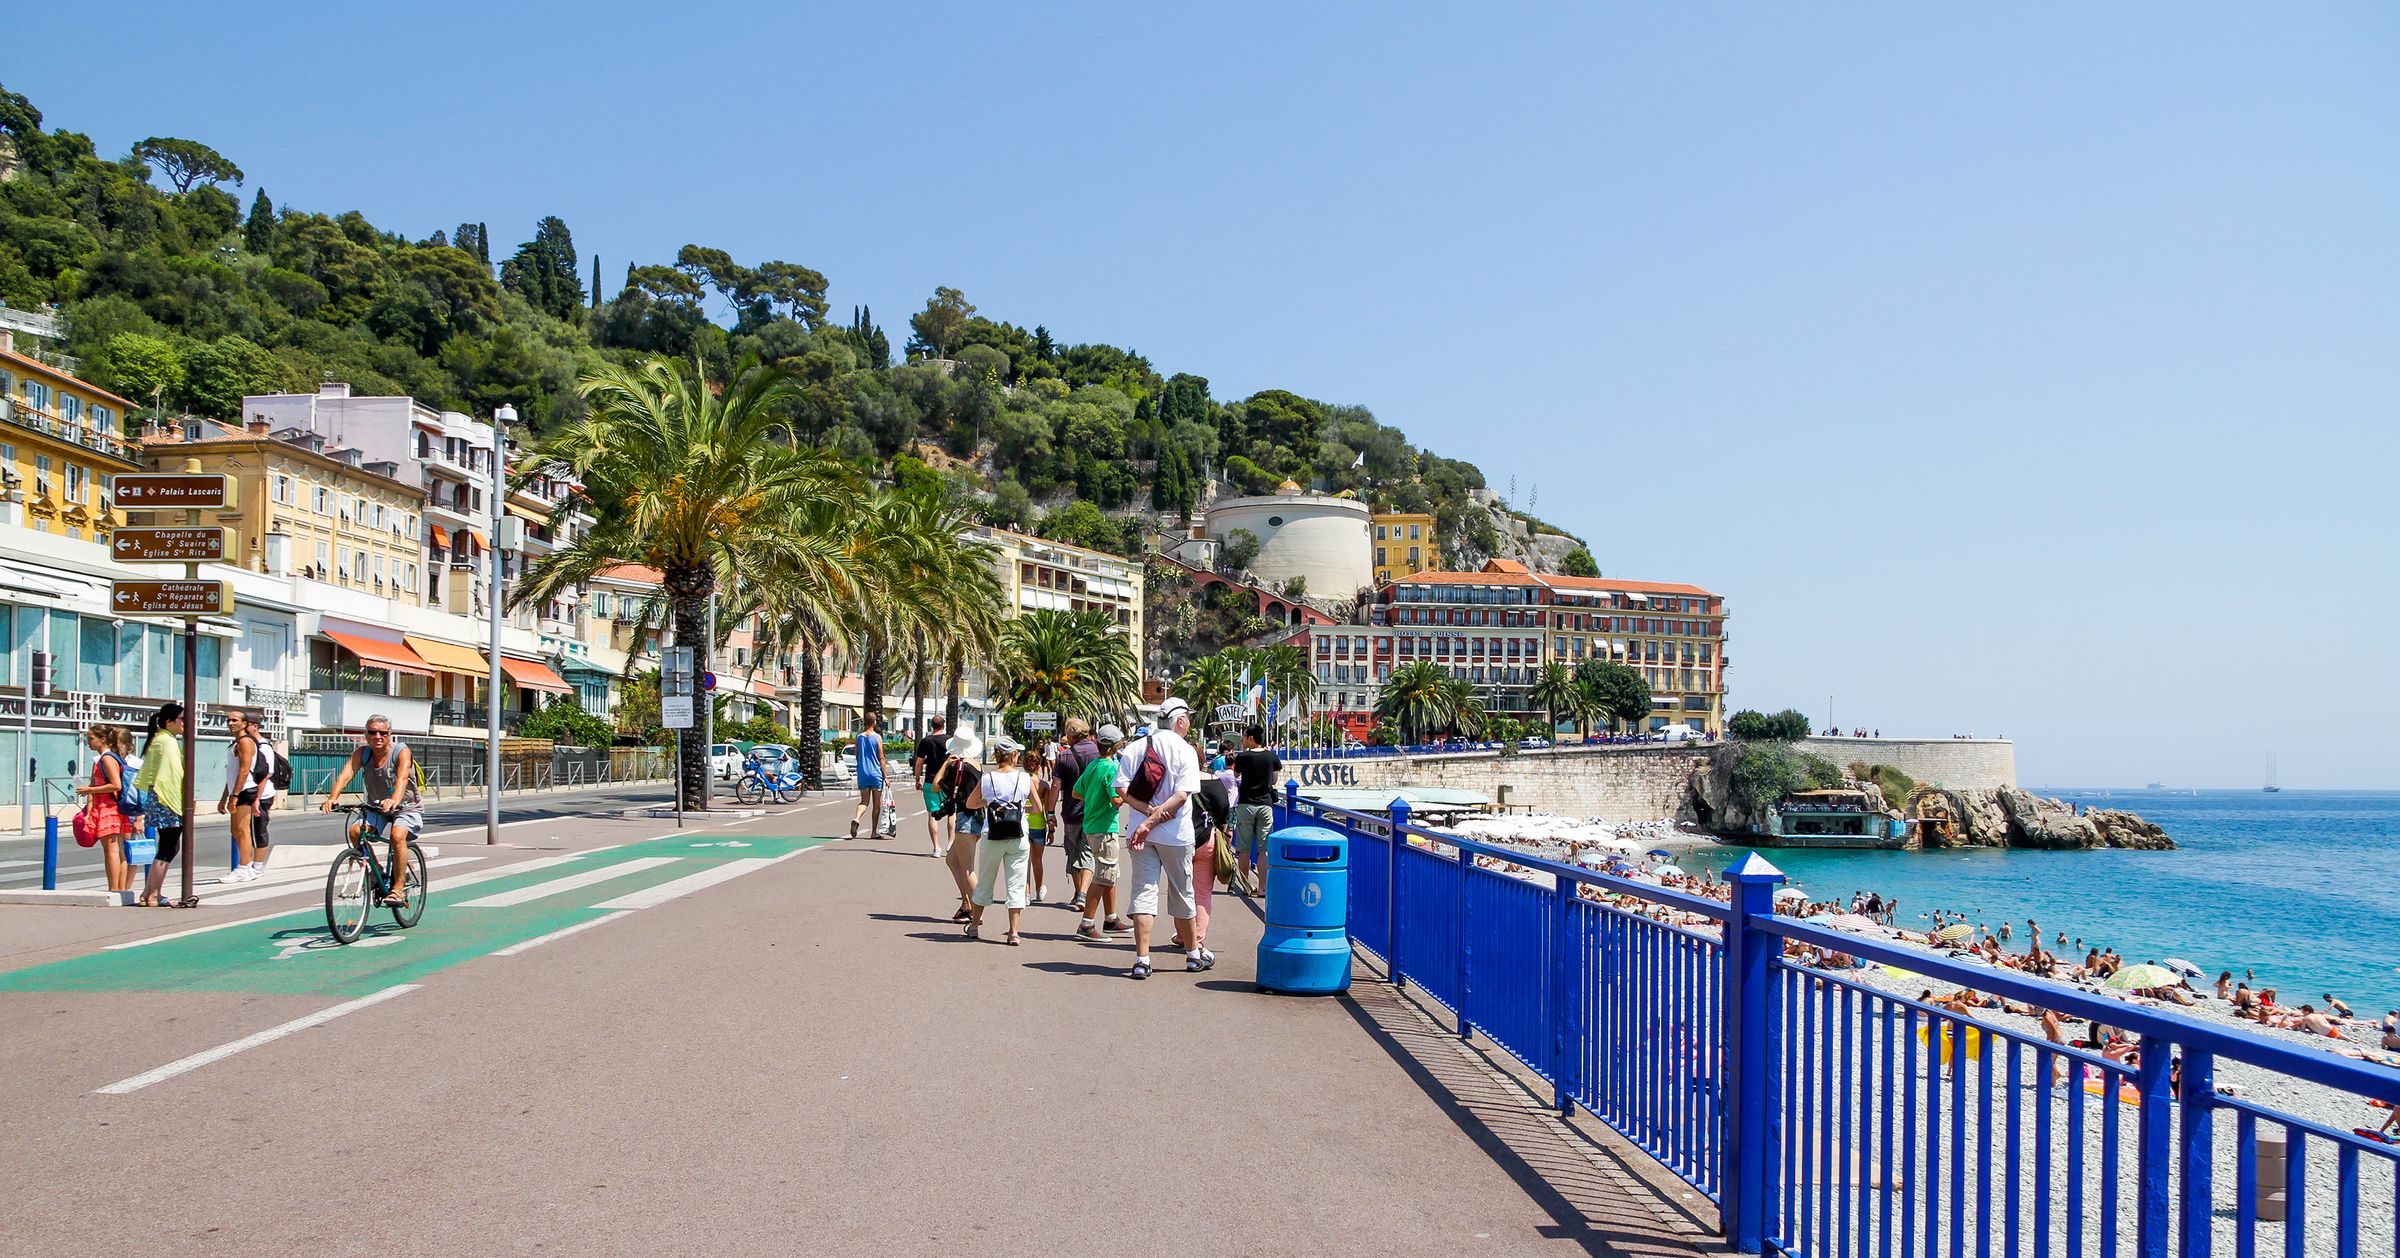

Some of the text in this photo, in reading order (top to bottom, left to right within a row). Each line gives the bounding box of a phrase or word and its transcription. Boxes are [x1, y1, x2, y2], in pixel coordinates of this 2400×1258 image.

[160, 487, 222, 496] Palais Lascaris
[154, 531, 193, 540] Chapelle
[179, 540, 207, 548] Suaire
[143, 549, 170, 558] Eglise
[161, 583, 204, 592] Cathédrale
[169, 593, 204, 602] Réparate
[142, 601, 167, 610] Eglise
[1219, 705, 1241, 720] CASTEL
[1300, 763, 1359, 787] CASTEL
